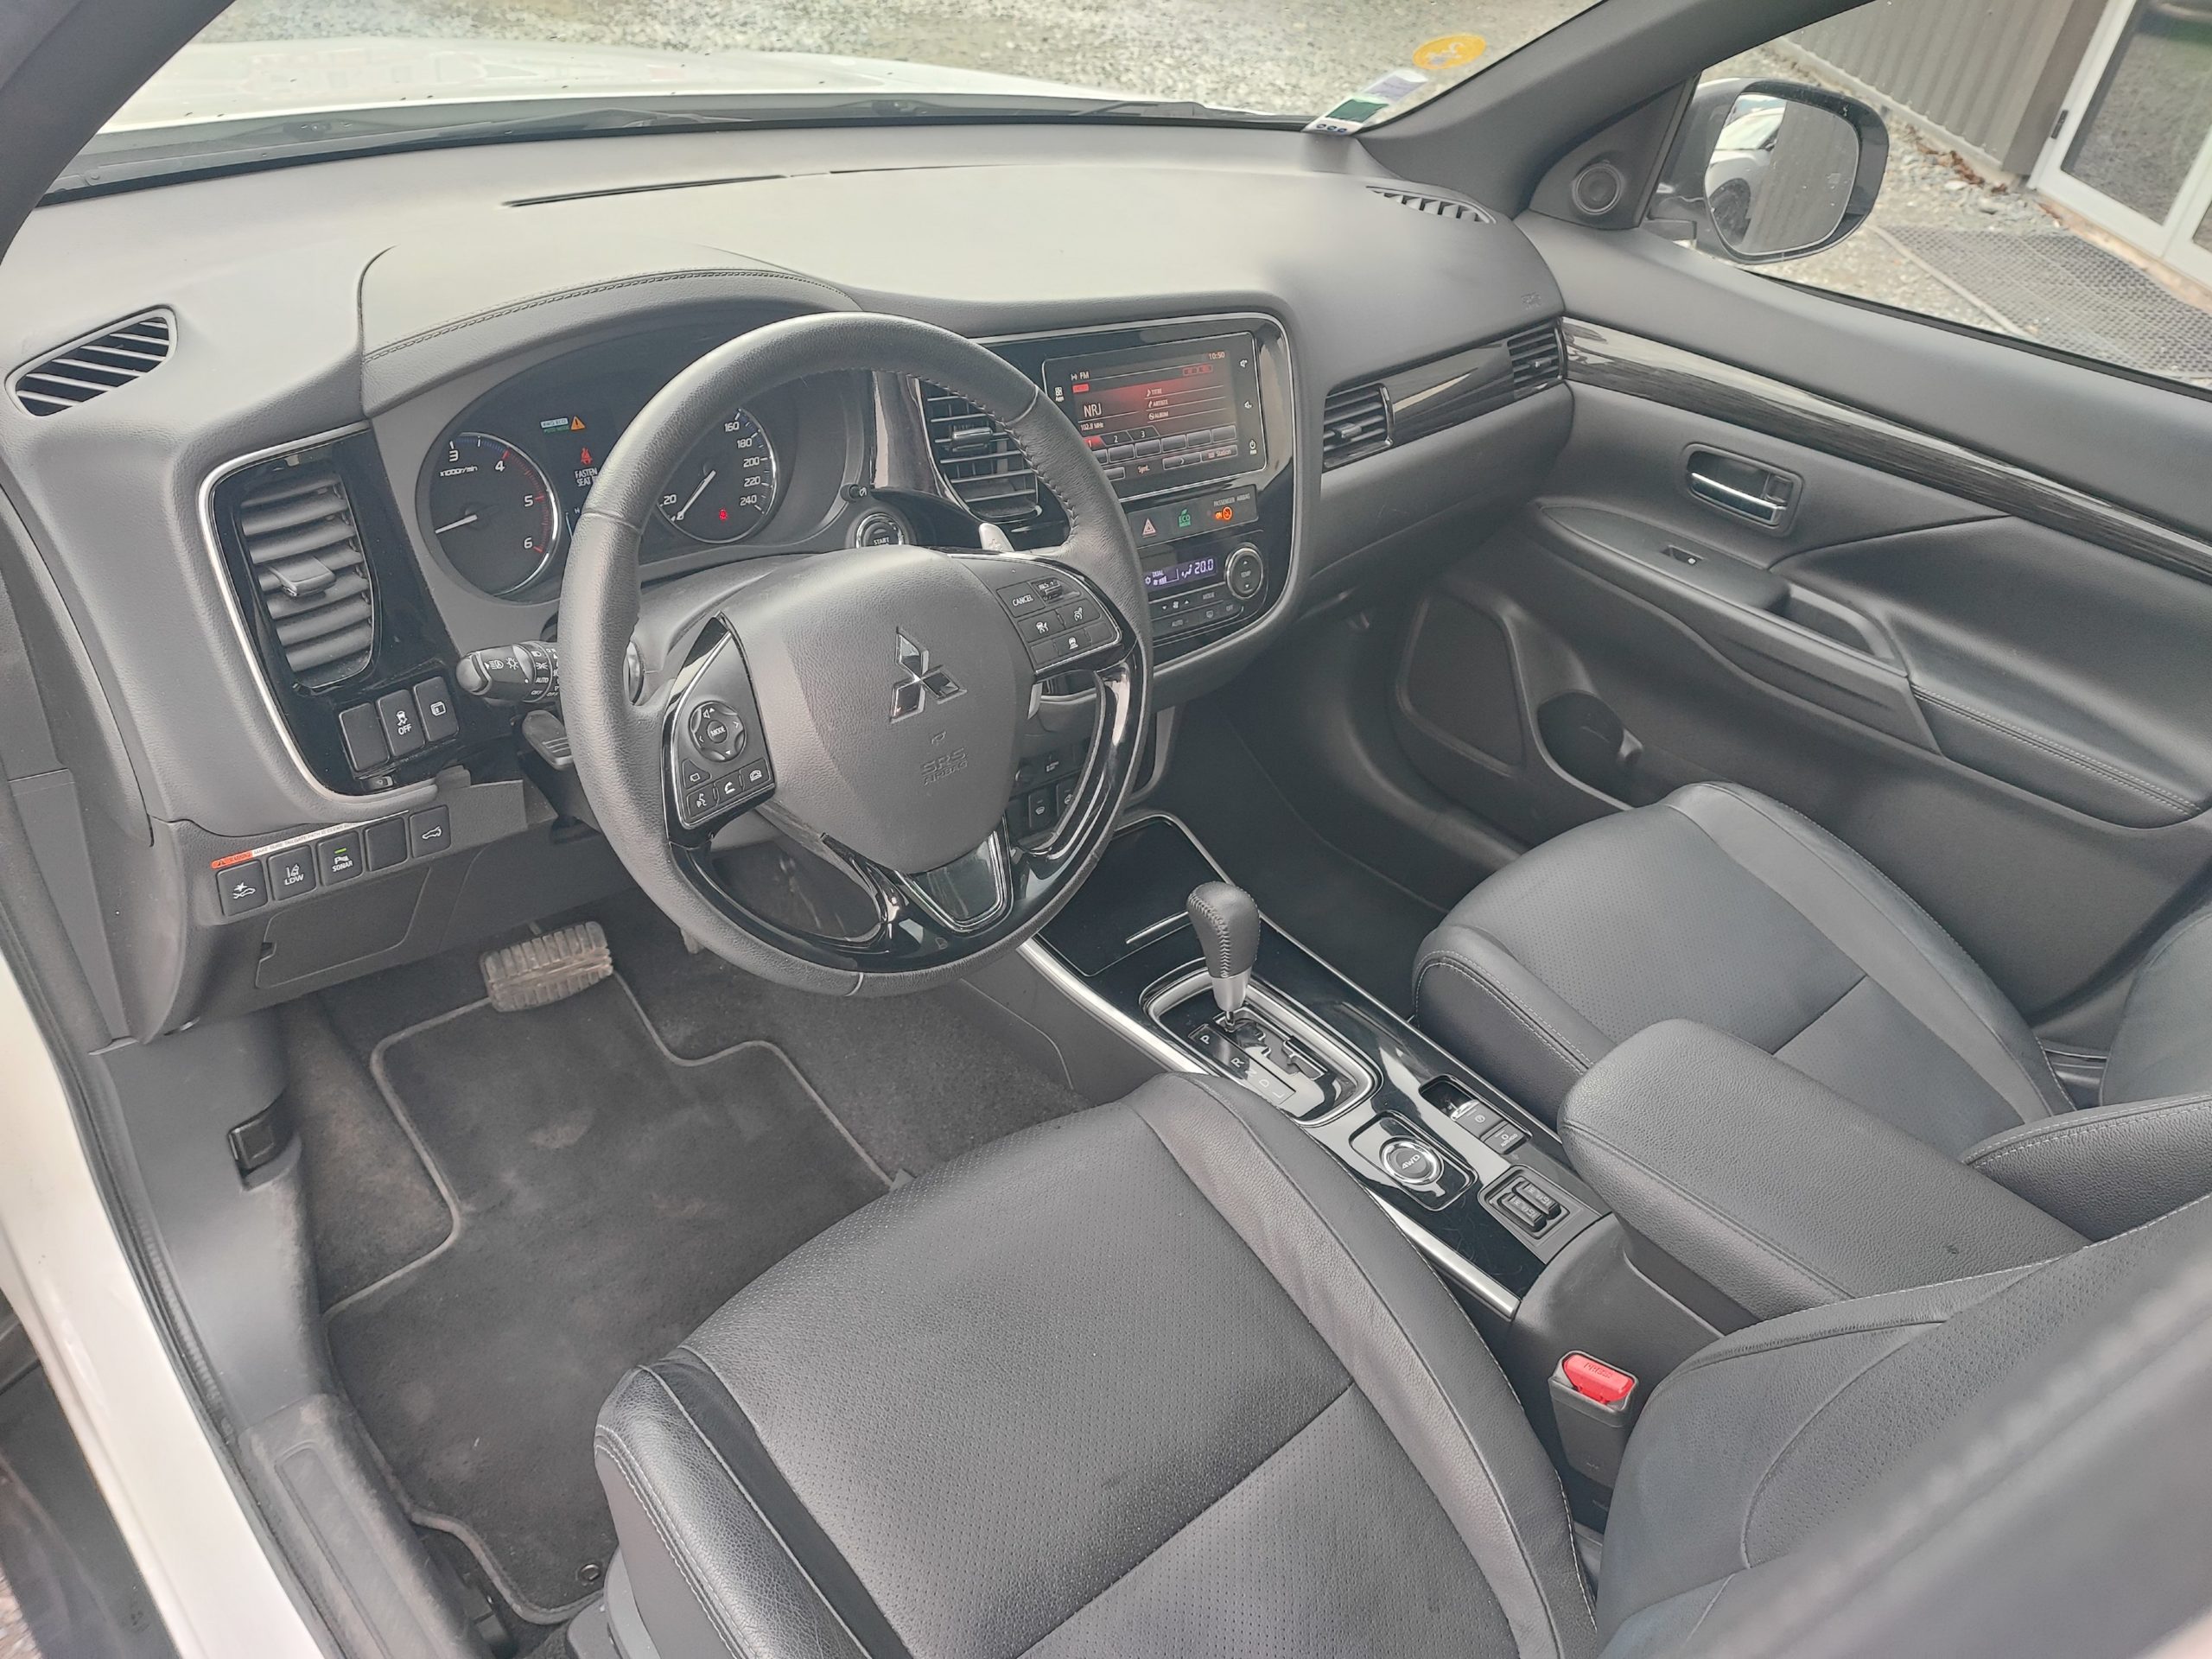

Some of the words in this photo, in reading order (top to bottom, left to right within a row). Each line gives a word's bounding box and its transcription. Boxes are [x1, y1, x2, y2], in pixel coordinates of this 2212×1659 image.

[1208, 352, 1225, 360] 10:50
[1079, 371, 1090, 380] FM
[1083, 403, 1103, 418] NRJ
[724, 421, 740, 433] 160
[737, 437, 753, 449] 180
[1113, 435, 1119, 443] 2
[449, 450, 459, 462] 3
[743, 456, 760, 468] 200
[494, 460, 505, 472] 4
[575, 467, 599, 480] FASTEN
[576, 476, 591, 487] SEAT
[743, 475, 761, 488] 220
[524, 494, 534, 507] 5
[663, 494, 677, 505] 20
[740, 494, 757, 506] 240
[1178, 514, 1191, 523] ECO
[524, 537, 533, 549] 6
[1194, 558, 1214, 575] 20.0
[1012, 594, 1034, 607] CANCEL
[397, 723, 411, 735] OFF
[710, 725, 727, 737] MODE
[921, 747, 966, 778] SRS
[332, 860, 353, 873] SONAR
[283, 873, 304, 886] LDW
[1199, 1034, 1211, 1045] P
[1230, 1057, 1245, 1068] R
[1258, 1078, 1270, 1089] D
[1271, 1090, 1285, 1099] L
[1402, 1154, 1421, 1170] 4WD
